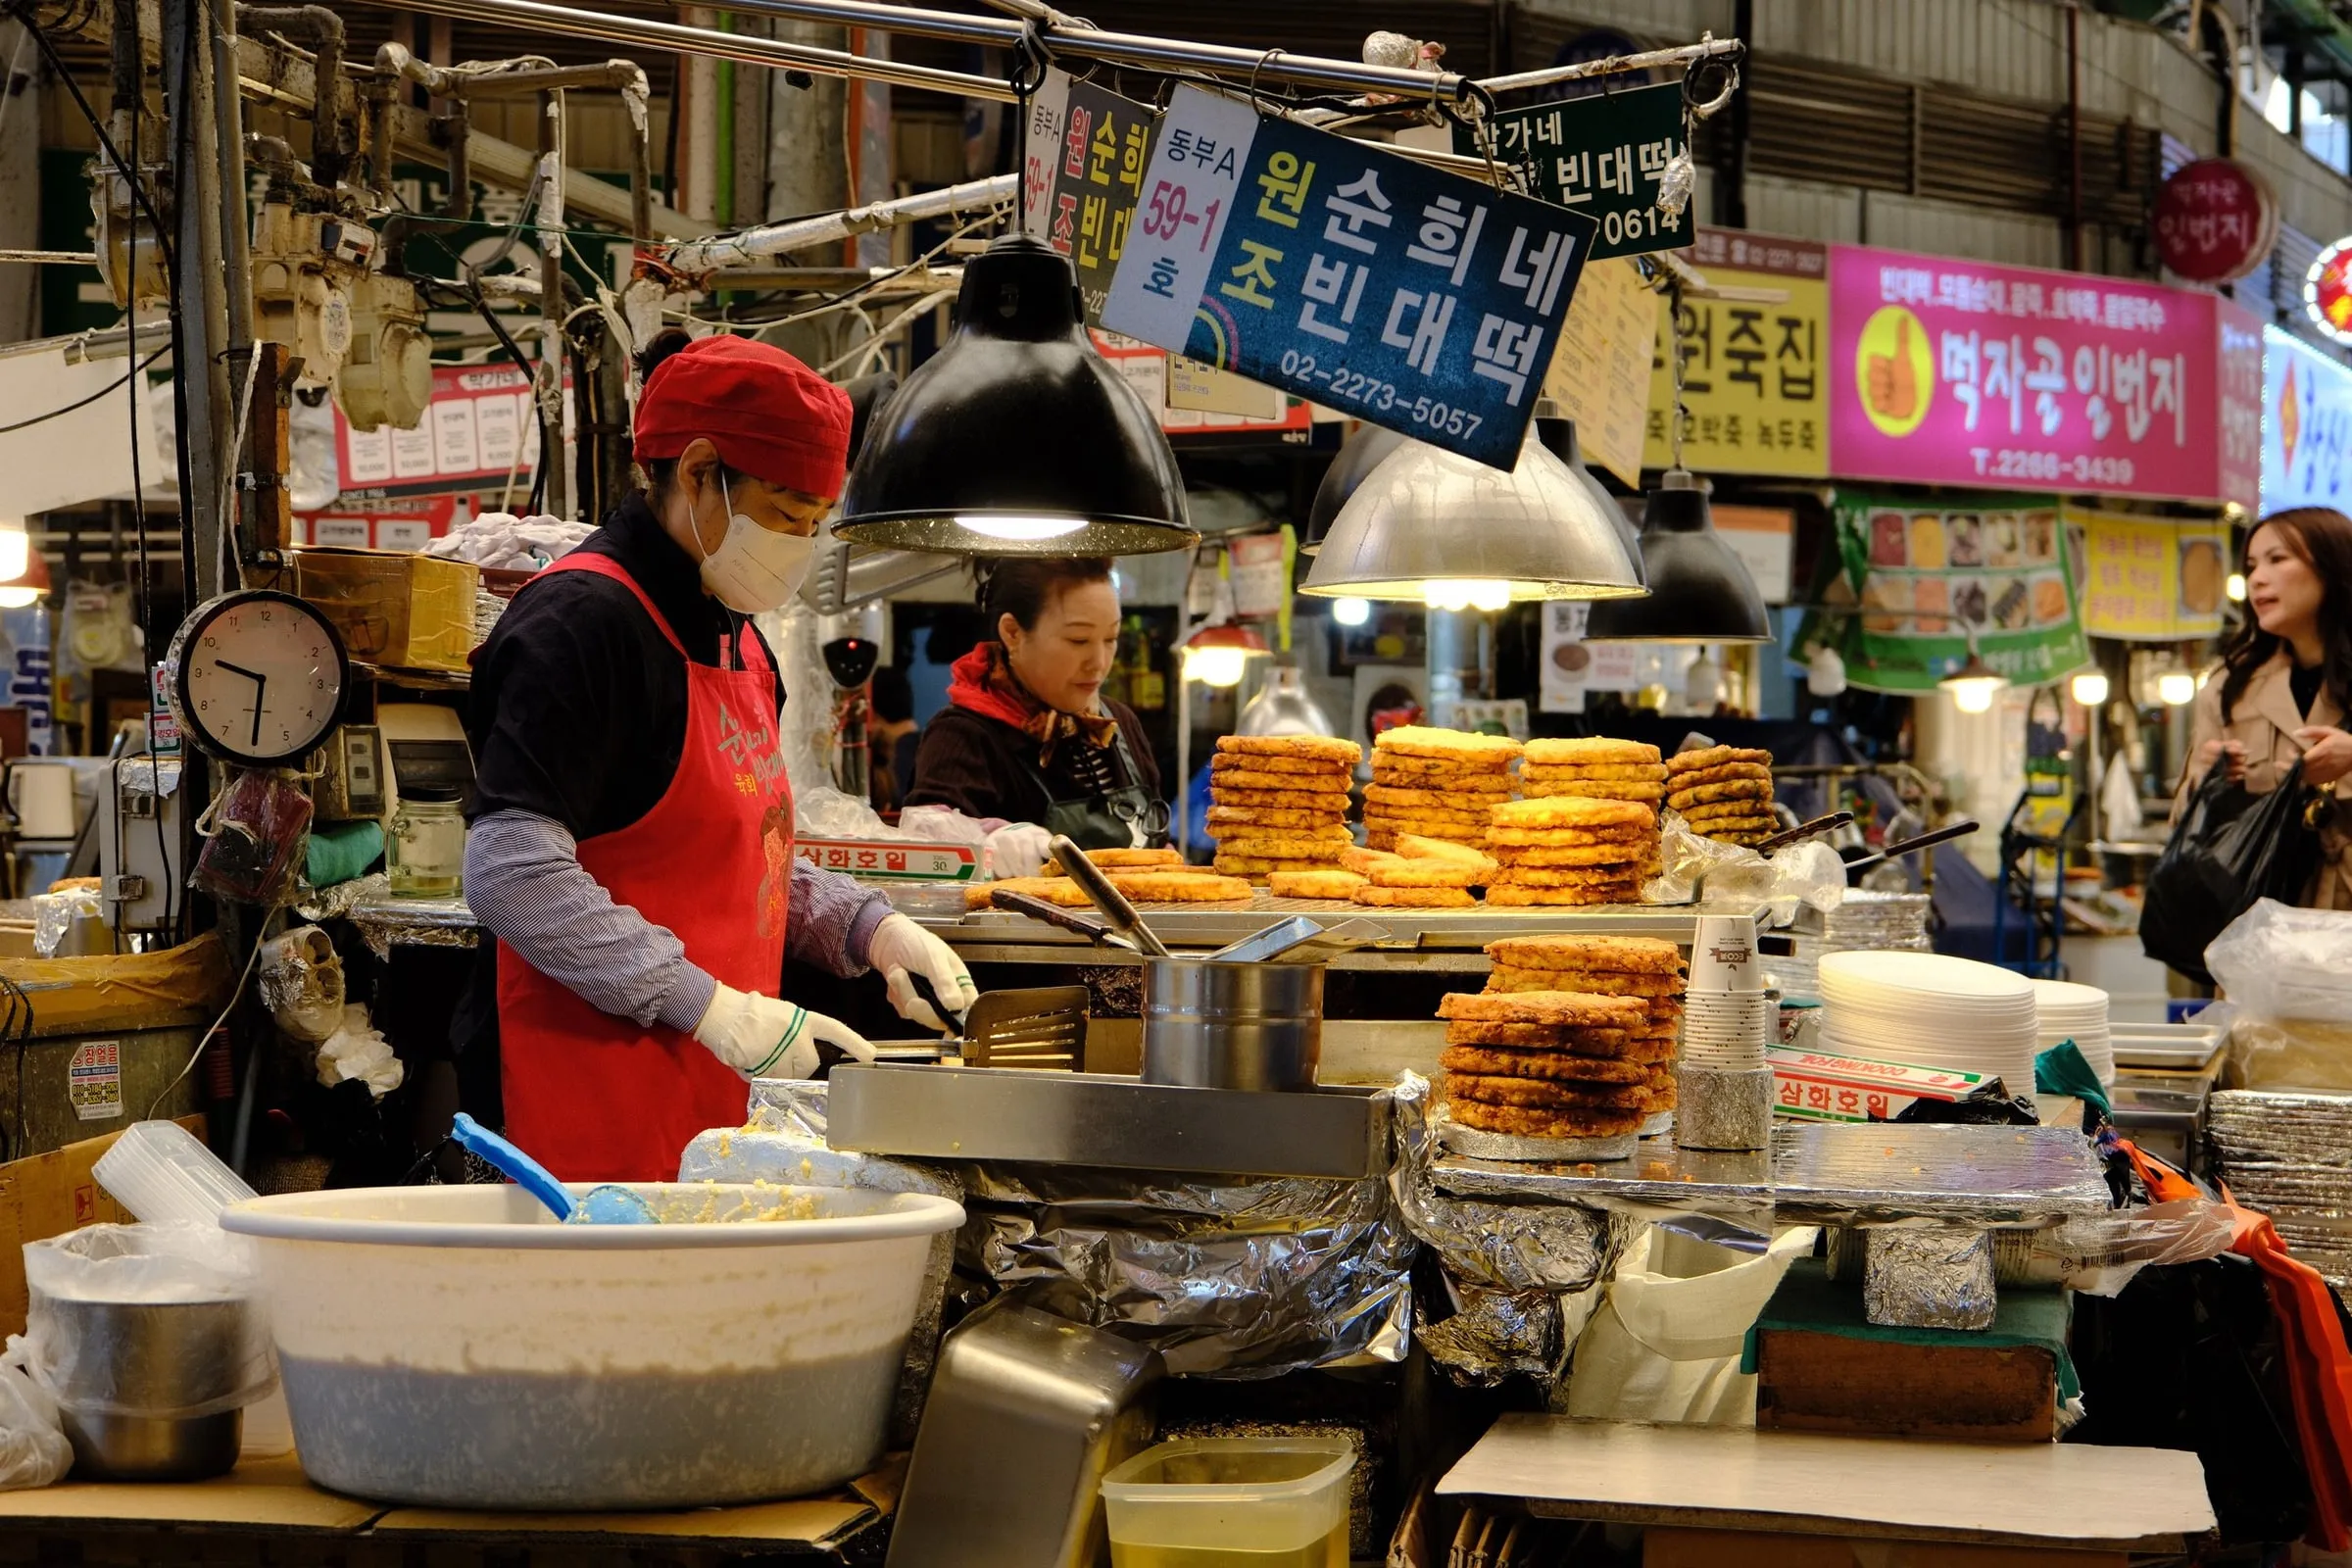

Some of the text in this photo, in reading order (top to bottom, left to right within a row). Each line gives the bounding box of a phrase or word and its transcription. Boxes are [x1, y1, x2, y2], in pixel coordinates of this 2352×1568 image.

[1034, 104, 1061, 144] 동부A
[1090, 110, 1150, 199] 순희
[1167, 128, 1237, 180] 동부A
[1557, 137, 1675, 205] 빈대떡
[1025, 156, 1055, 217] 59-1
[1079, 194, 1138, 270] 빈대
[1143, 179, 1221, 254] 59-1
[1322, 168, 1578, 317] 순희네
[1142, 257, 1180, 299] 호
[1297, 254, 1544, 408] 빈대떡
[1653, 303, 1816, 401] 원죽집
[1280, 350, 1483, 441] 02-2273-5057
[229, 616, 238, 626] 11
[260, 611, 271, 621] 12
[204, 637, 217, 648] 10
[312, 647, 319, 658] 2
[194, 668, 202, 678] 9
[317, 679, 324, 689] 3
[200, 701, 208, 710] 8
[306, 710, 313, 719] 4
[221, 725, 229, 736] 7
[283, 730, 290, 741] 5
[799, 847, 906, 871] 삼화호일
[1829, 1057, 1908, 1076] COOKING
[1780, 1081, 1888, 1120] 삼화호일
